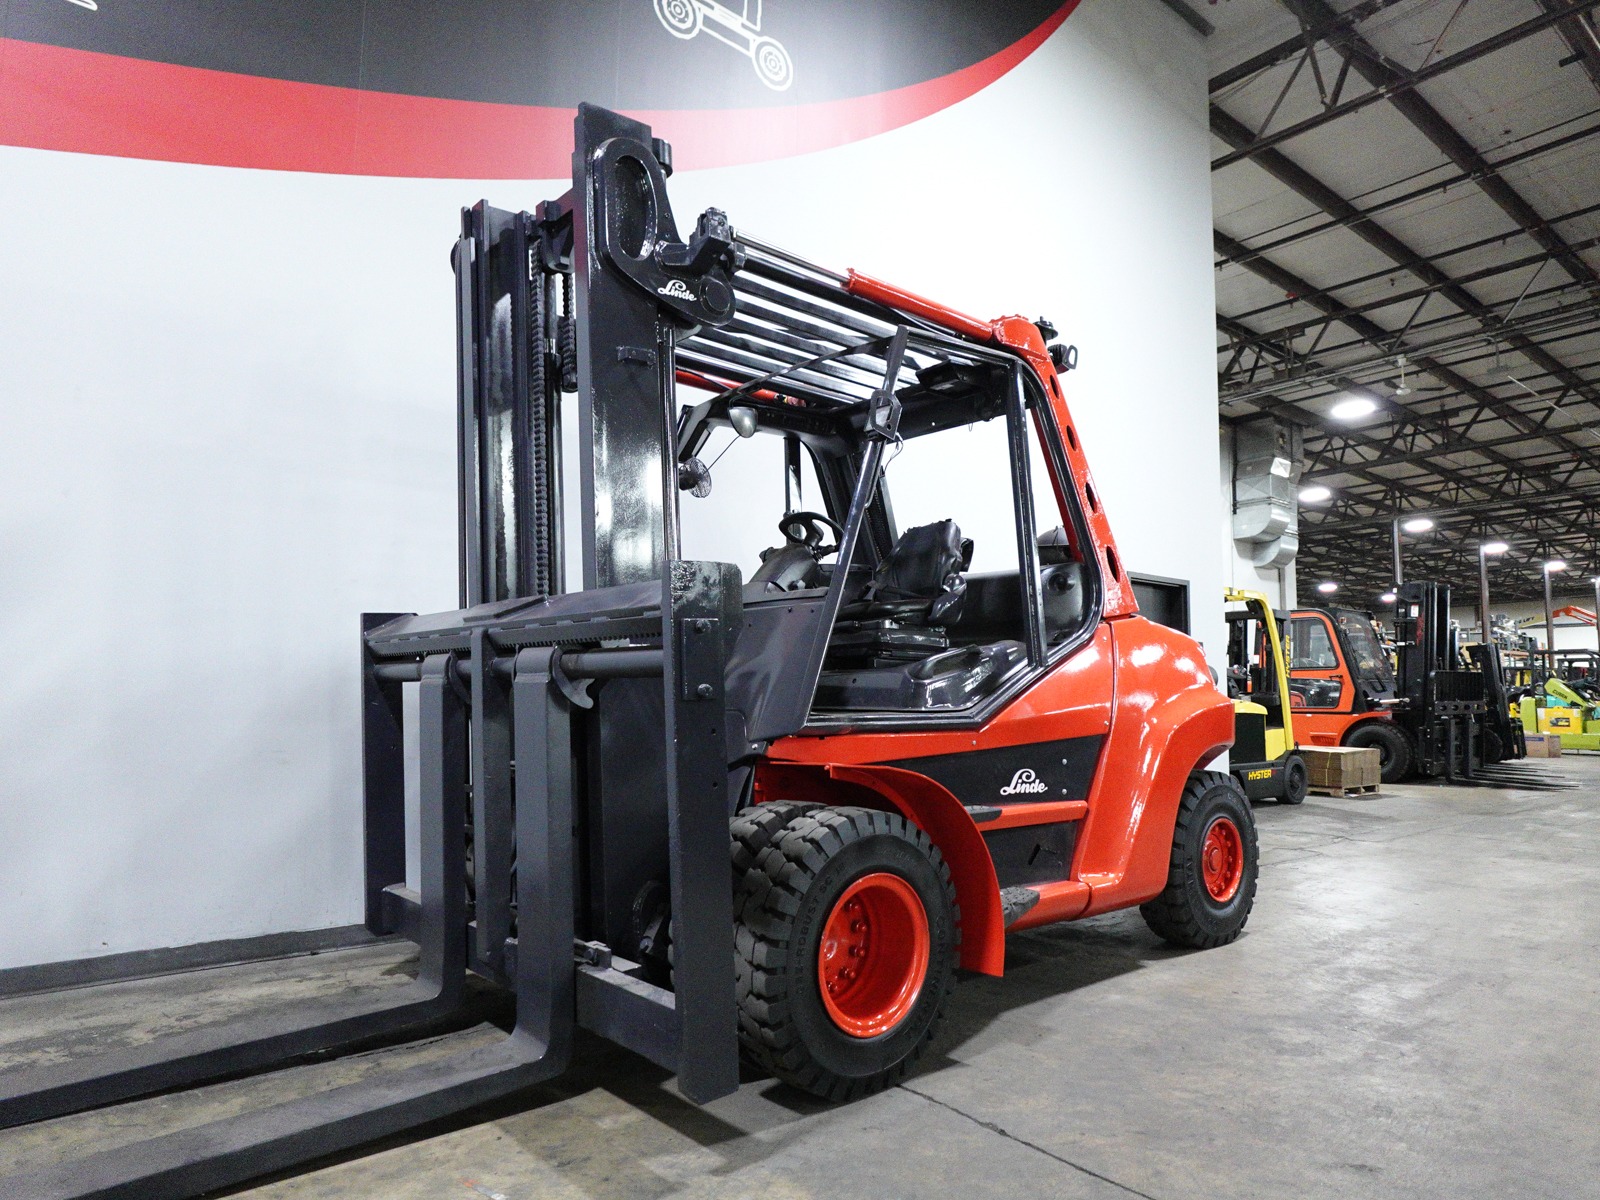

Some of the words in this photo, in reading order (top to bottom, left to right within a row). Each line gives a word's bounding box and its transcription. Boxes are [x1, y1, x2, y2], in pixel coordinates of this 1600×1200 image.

[657, 279, 698, 302] Linde
[1000, 768, 1049, 796] Linde
[1248, 769, 1272, 780] HYSTER
